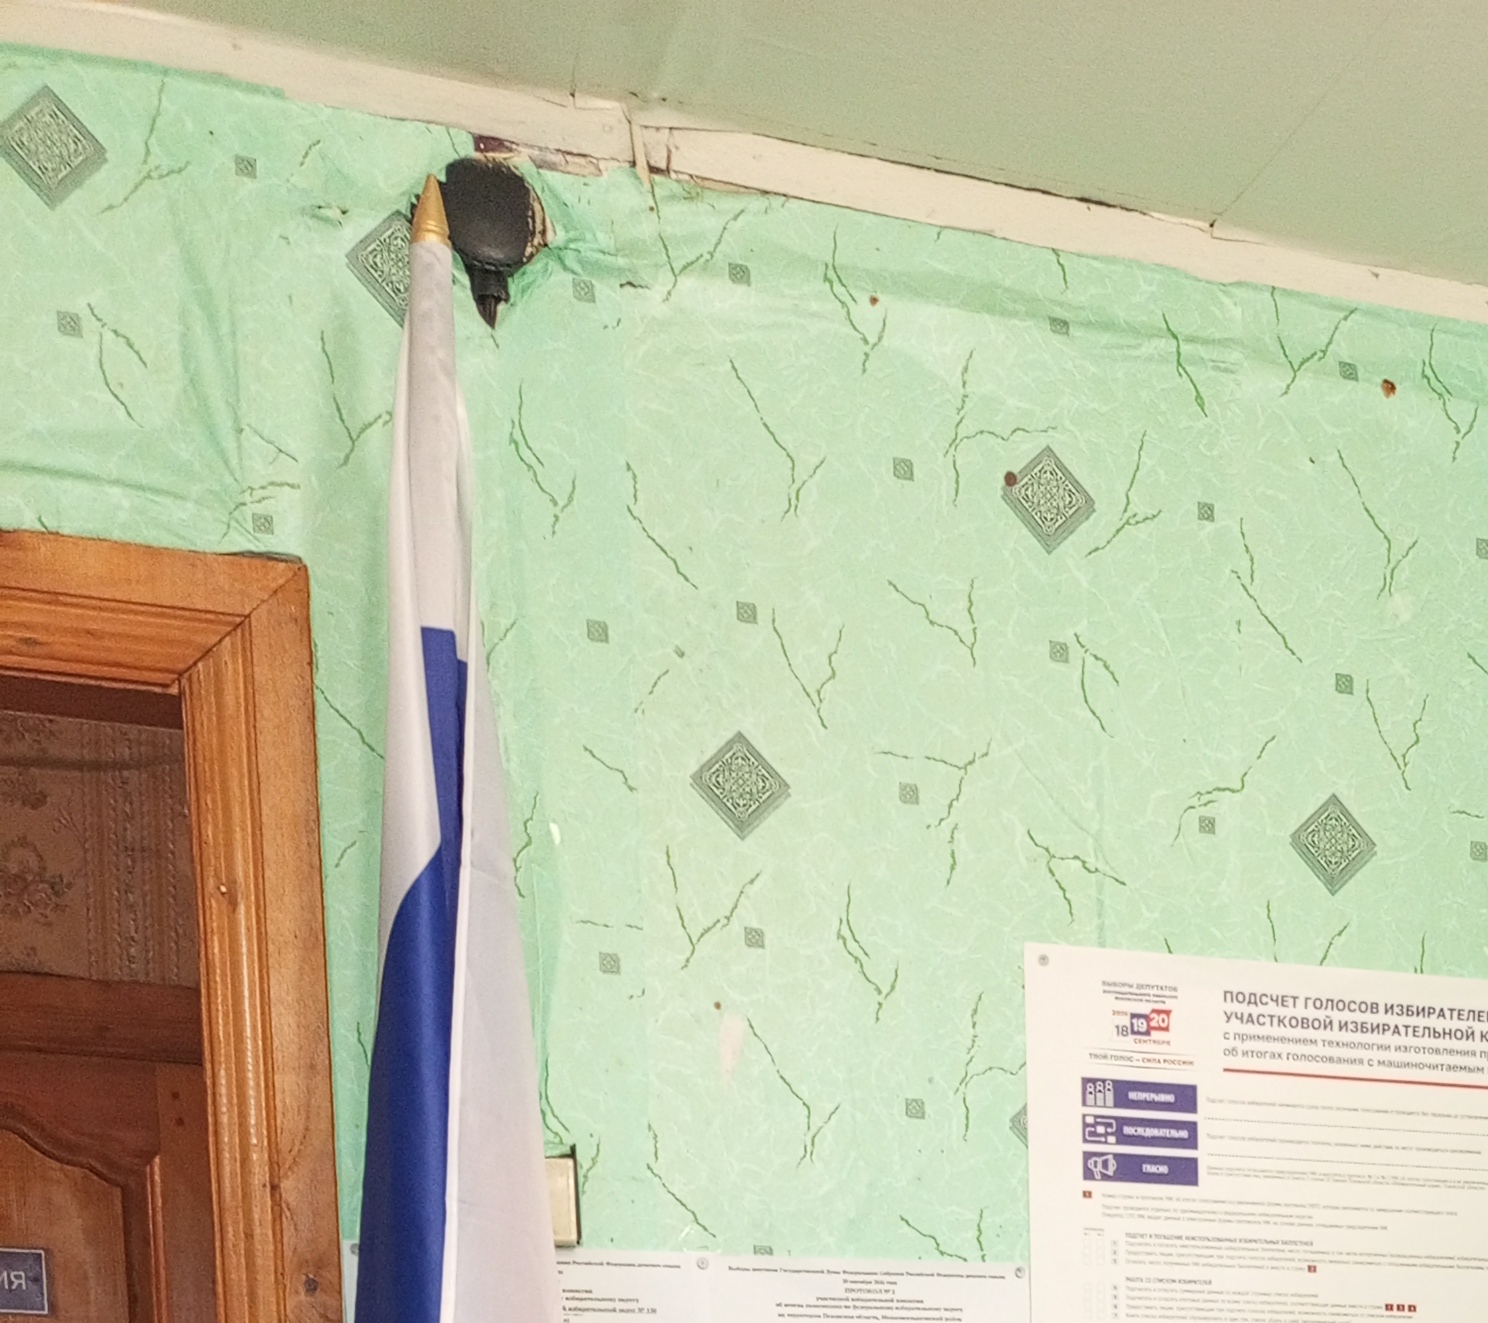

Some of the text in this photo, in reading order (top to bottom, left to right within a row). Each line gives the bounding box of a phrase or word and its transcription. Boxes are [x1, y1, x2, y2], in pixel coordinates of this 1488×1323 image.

[1223, 990, 1300, 1009] ПОДСЧЕТ
[1304, 997, 1380, 1014] ГОЛОСОВ
[1115, 1013, 1169, 1037] 18 19 20
[1223, 1011, 1334, 1032] УЧАСТКОВОЙ
[1338, 1020, 1476, 1043] ИЗБИРАТЕЛЬНОЙ
[1223, 1032, 1230, 1041] с
[1233, 1032, 1318, 1048] применением
[1321, 1038, 1391, 1053] технологии
[1394, 1044, 1477, 1059] изготовления
[1223, 1047, 1238, 1057] об
[1242, 1049, 1283, 1061] итогах
[1286, 1052, 1364, 1067] голосования
[1367, 1058, 1374, 1067] с
[1377, 1058, 1485, 1074] машиночитаемым
[1142, 1163, 1169, 1174] ГЛАСНО
